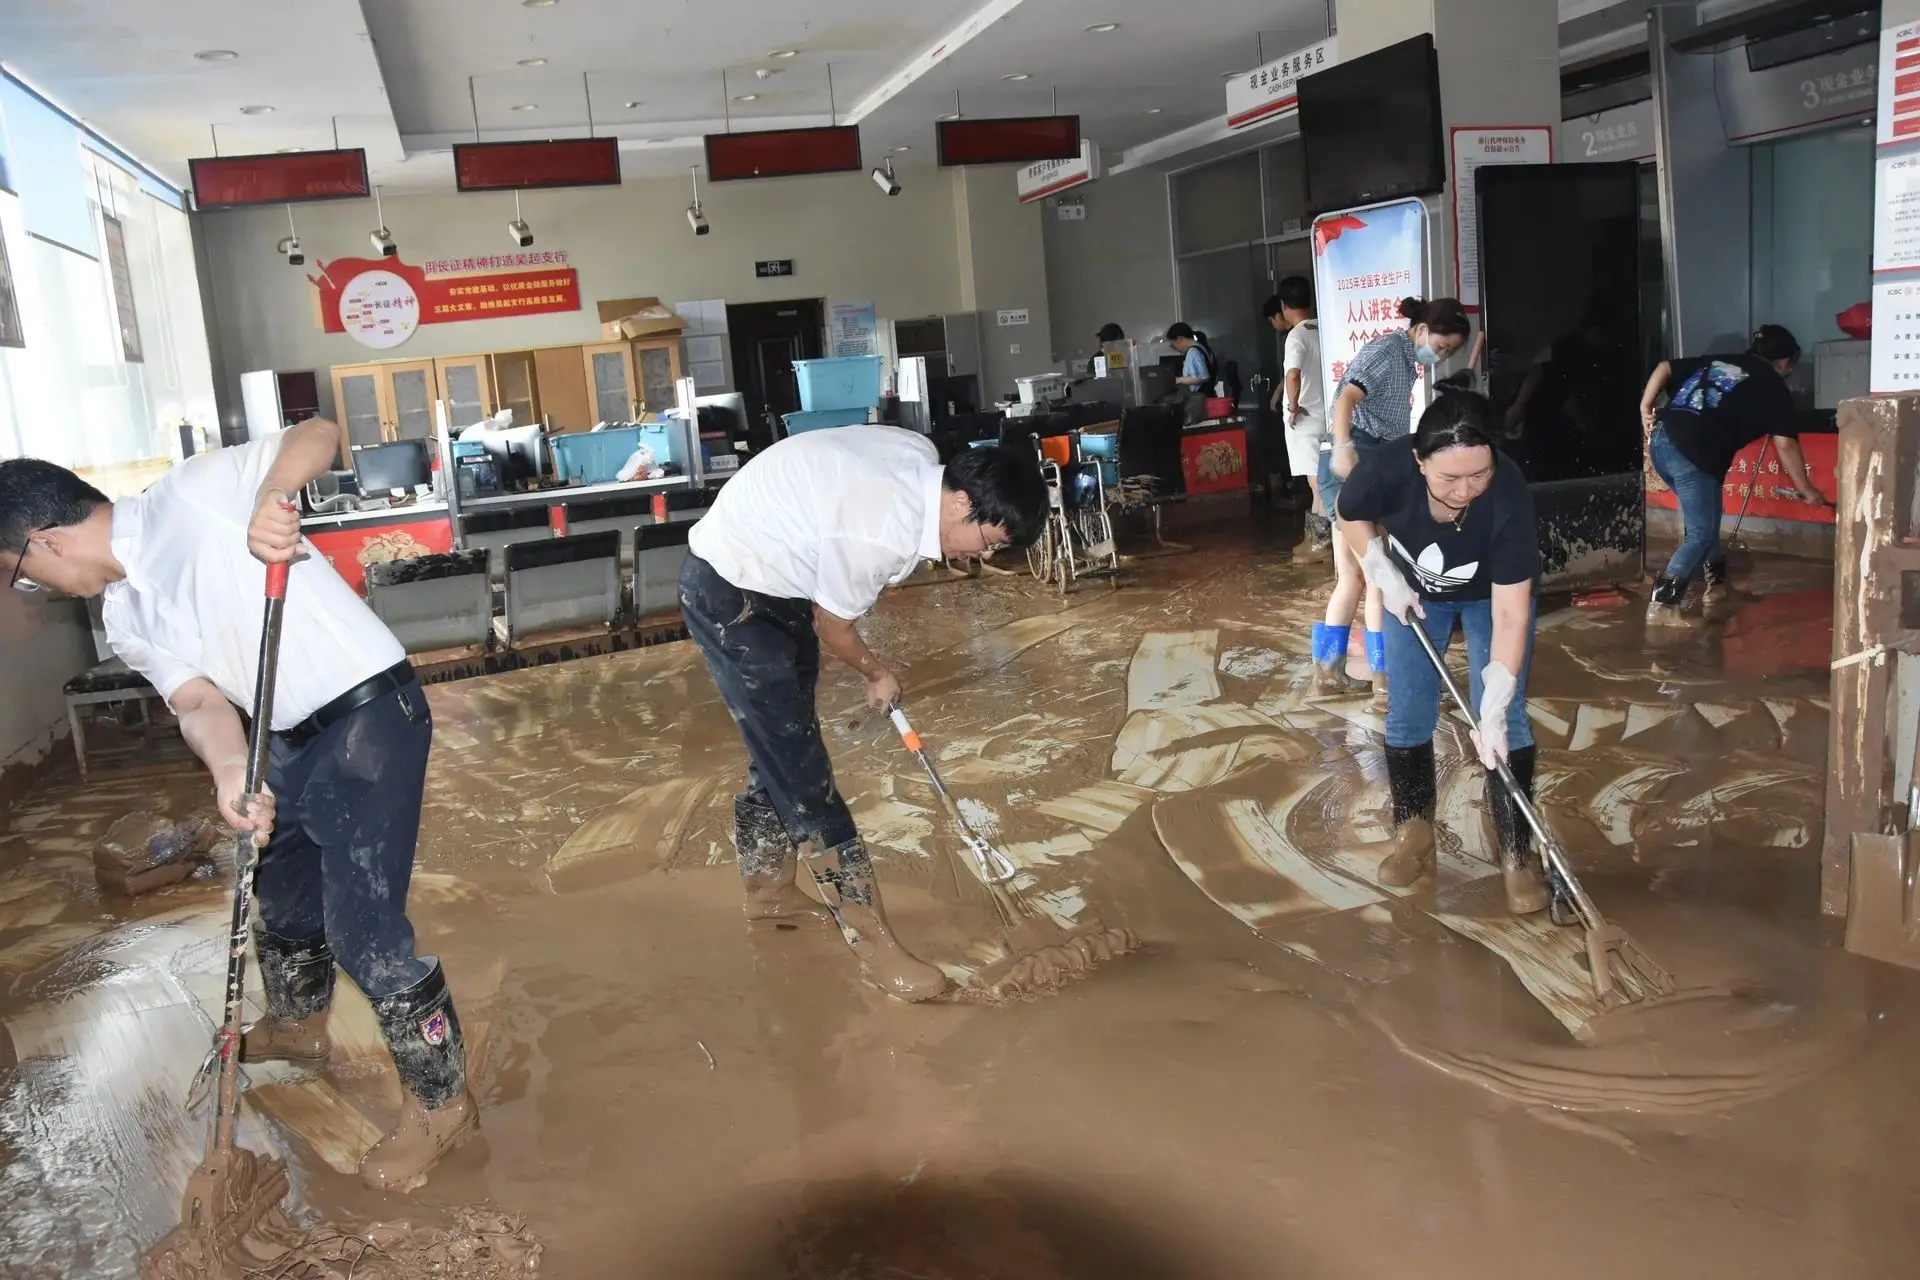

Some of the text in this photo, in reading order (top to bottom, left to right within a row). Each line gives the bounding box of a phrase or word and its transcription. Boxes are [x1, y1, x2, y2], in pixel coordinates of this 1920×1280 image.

[1249, 46, 1325, 91] 现金业务服务区
[1268, 82, 1282, 95] CASH
[1800, 80, 1820, 110] 3
[1582, 120, 1638, 157] 2 现金业务
[424, 251, 567, 274] 用长征精神打造吴起支行
[1337, 270, 1410, 290] 2025年全国安全生产月
[374, 296, 415, 309] 长征精神
